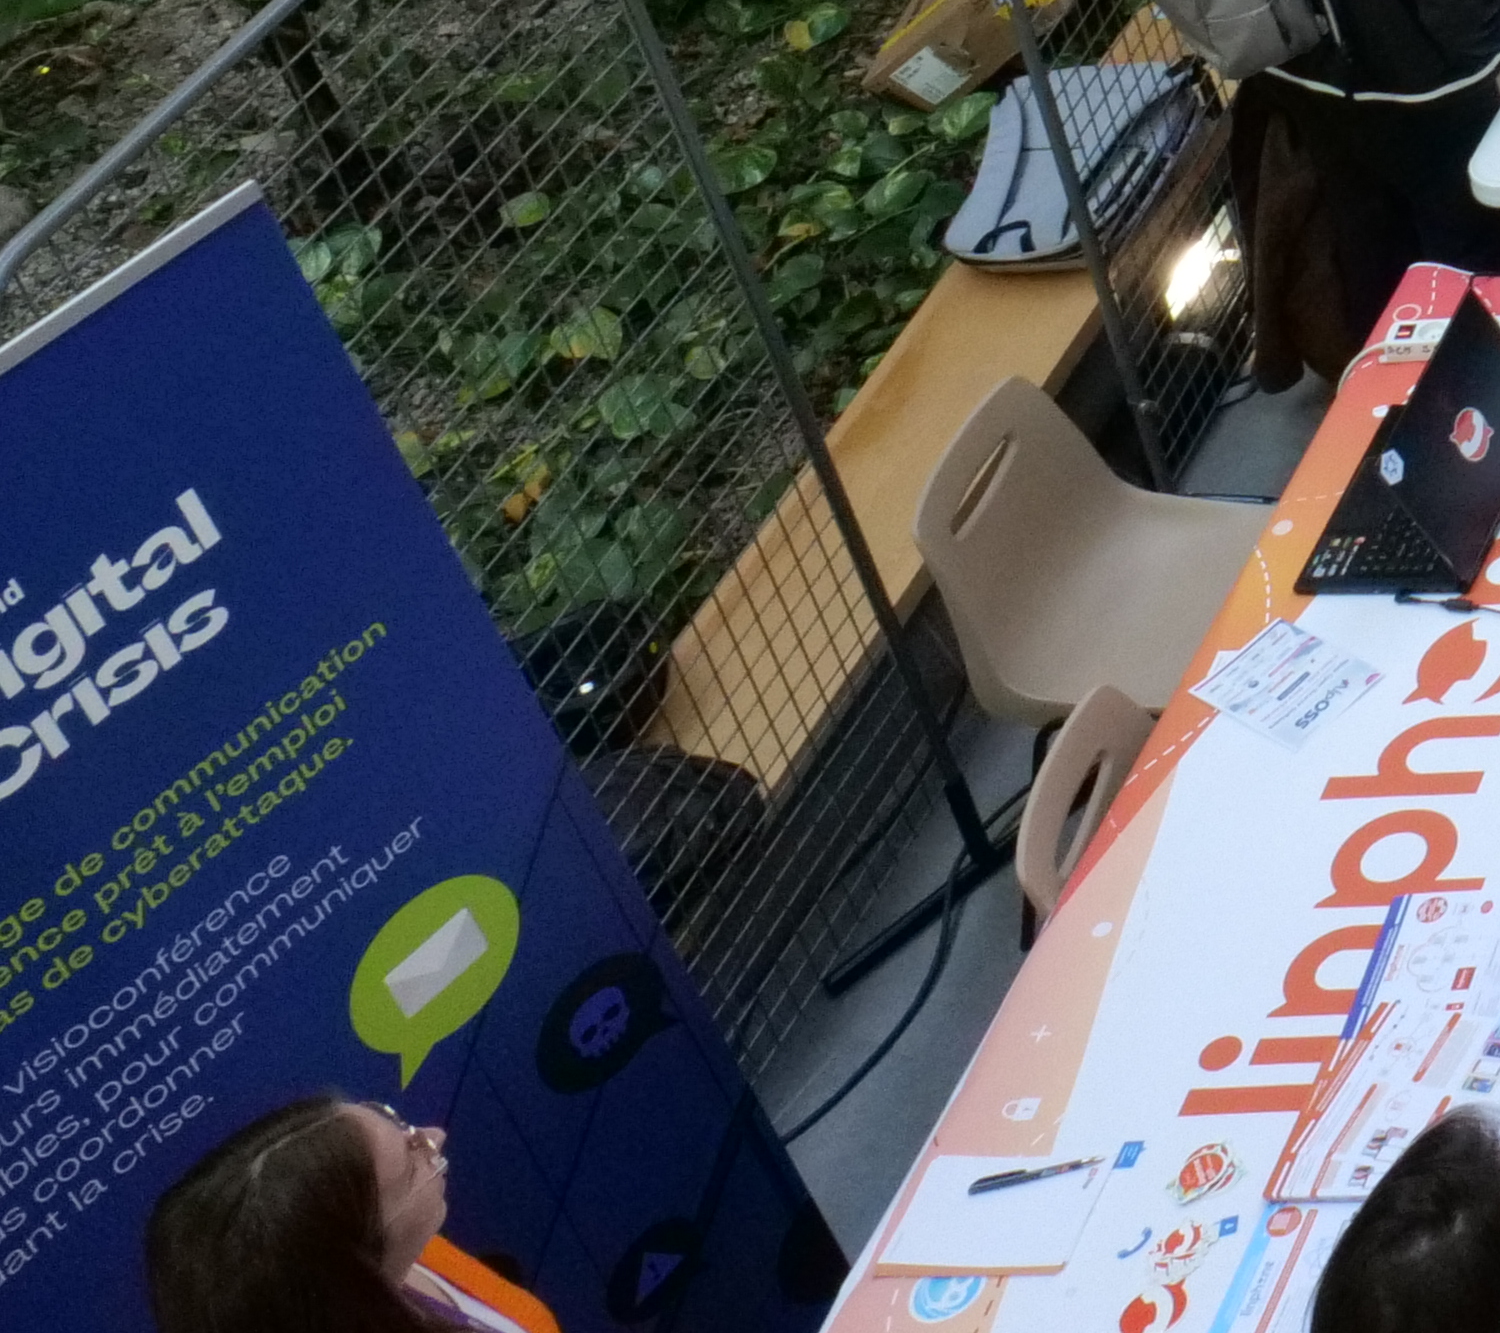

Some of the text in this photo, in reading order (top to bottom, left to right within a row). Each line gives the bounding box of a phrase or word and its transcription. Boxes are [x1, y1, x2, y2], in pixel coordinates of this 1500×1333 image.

[42, 944, 95, 991] de
[101, 736, 354, 945] cyberattaque.
[55, 851, 104, 897] de
[111, 620, 388, 850] communication
[94, 833, 175, 914] prêt
[177, 807, 205, 837] à
[204, 688, 349, 812] l'emploi
[2, 853, 293, 1098] visioconférence
[64, 842, 352, 1090] immédiatement
[94, 1025, 183, 1113] pour
[194, 814, 424, 1027] communiquer
[33, 1010, 247, 1204] coordonner
[67, 1178, 109, 1214] la
[112, 1092, 216, 1176] crise.
